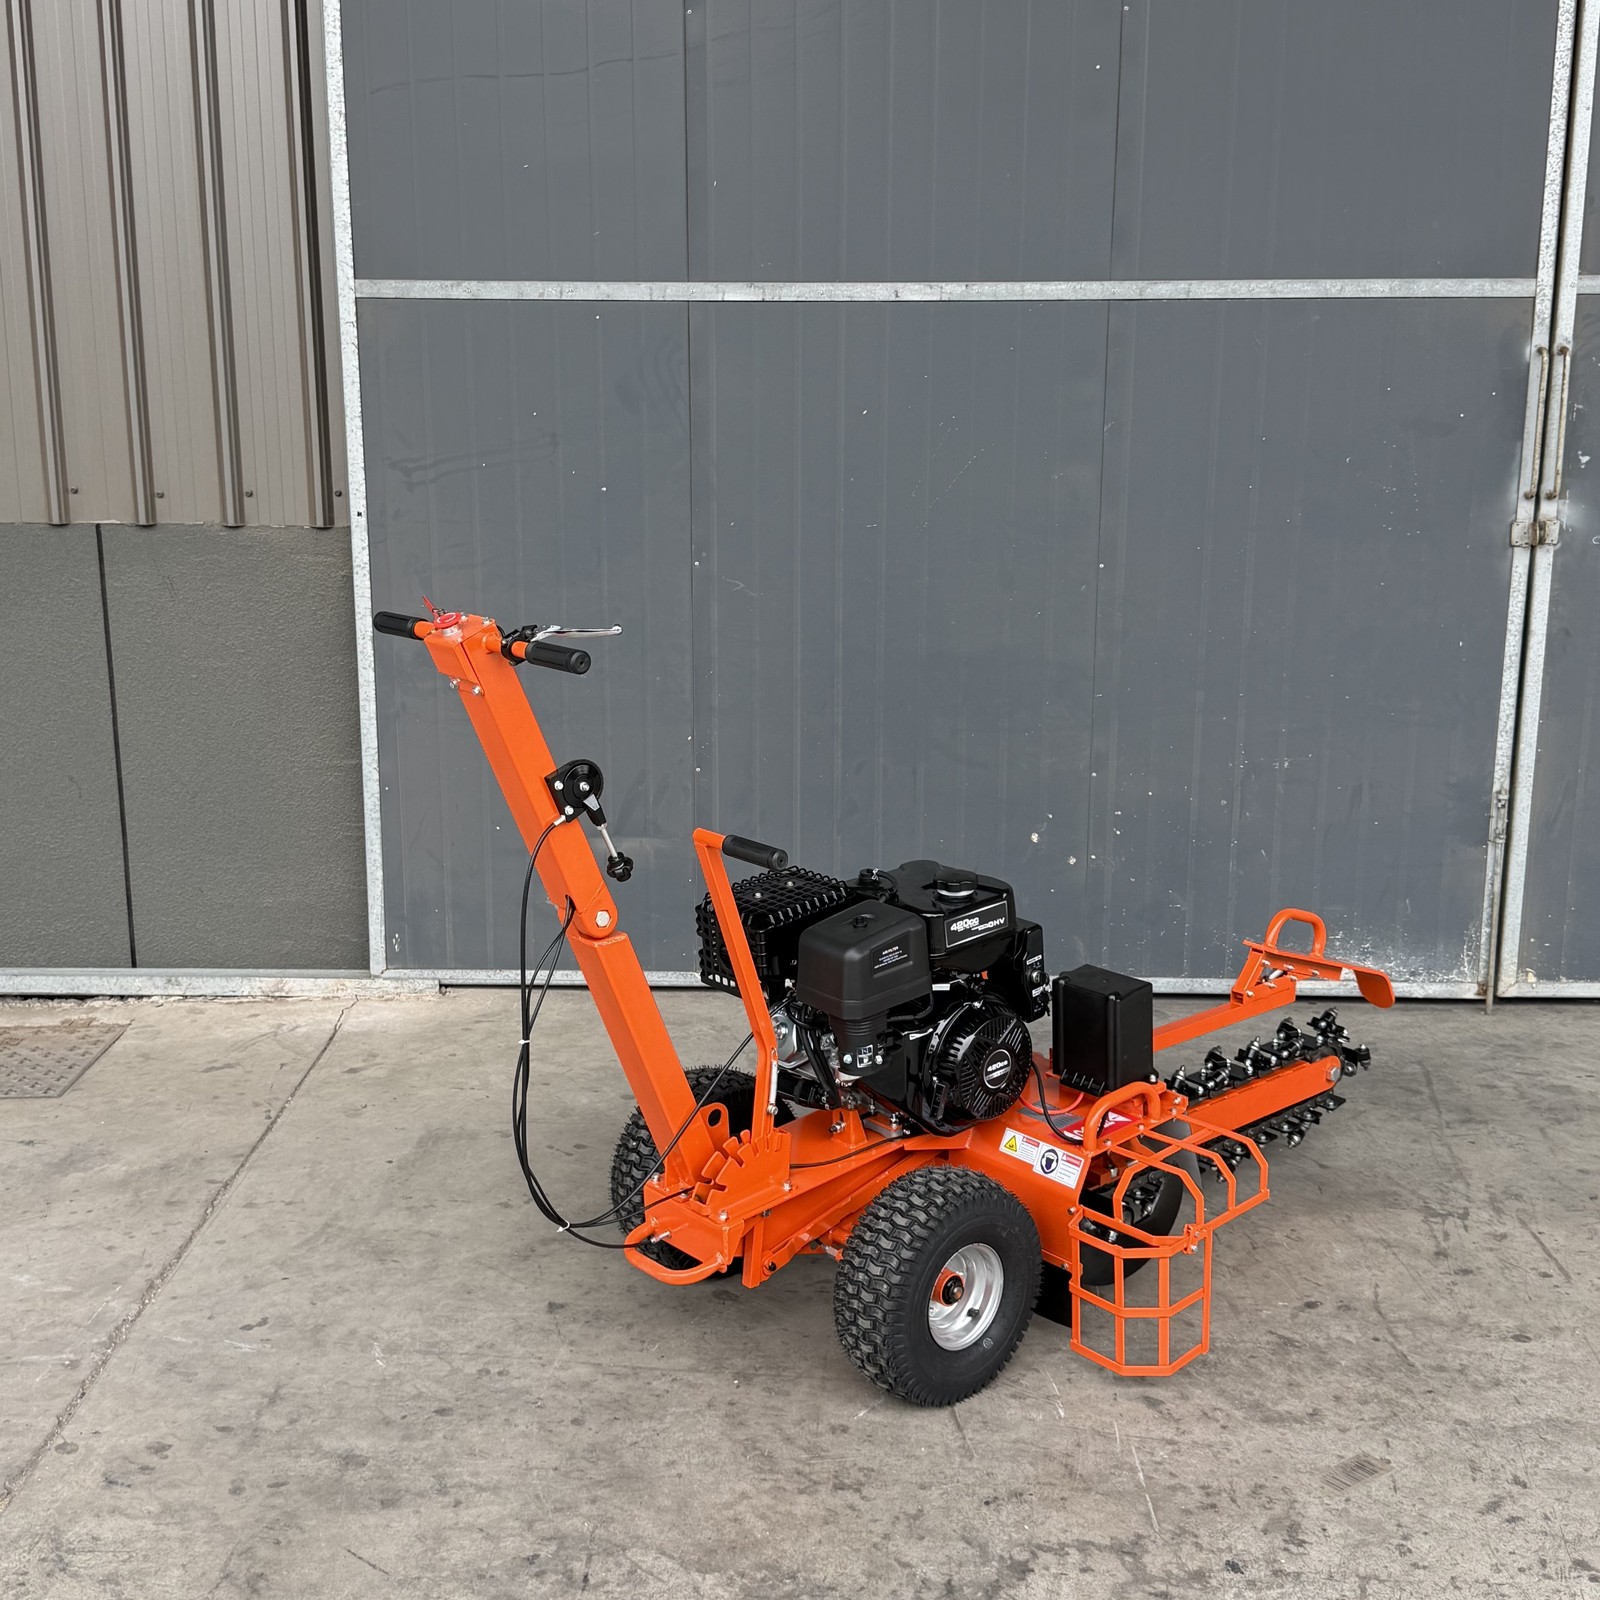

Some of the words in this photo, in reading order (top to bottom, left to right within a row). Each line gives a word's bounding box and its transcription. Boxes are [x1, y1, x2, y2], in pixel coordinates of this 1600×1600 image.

[950, 917, 980, 931] 420cc
[988, 917, 1005, 928] OHV
[987, 1060, 1008, 1072] 420cc
